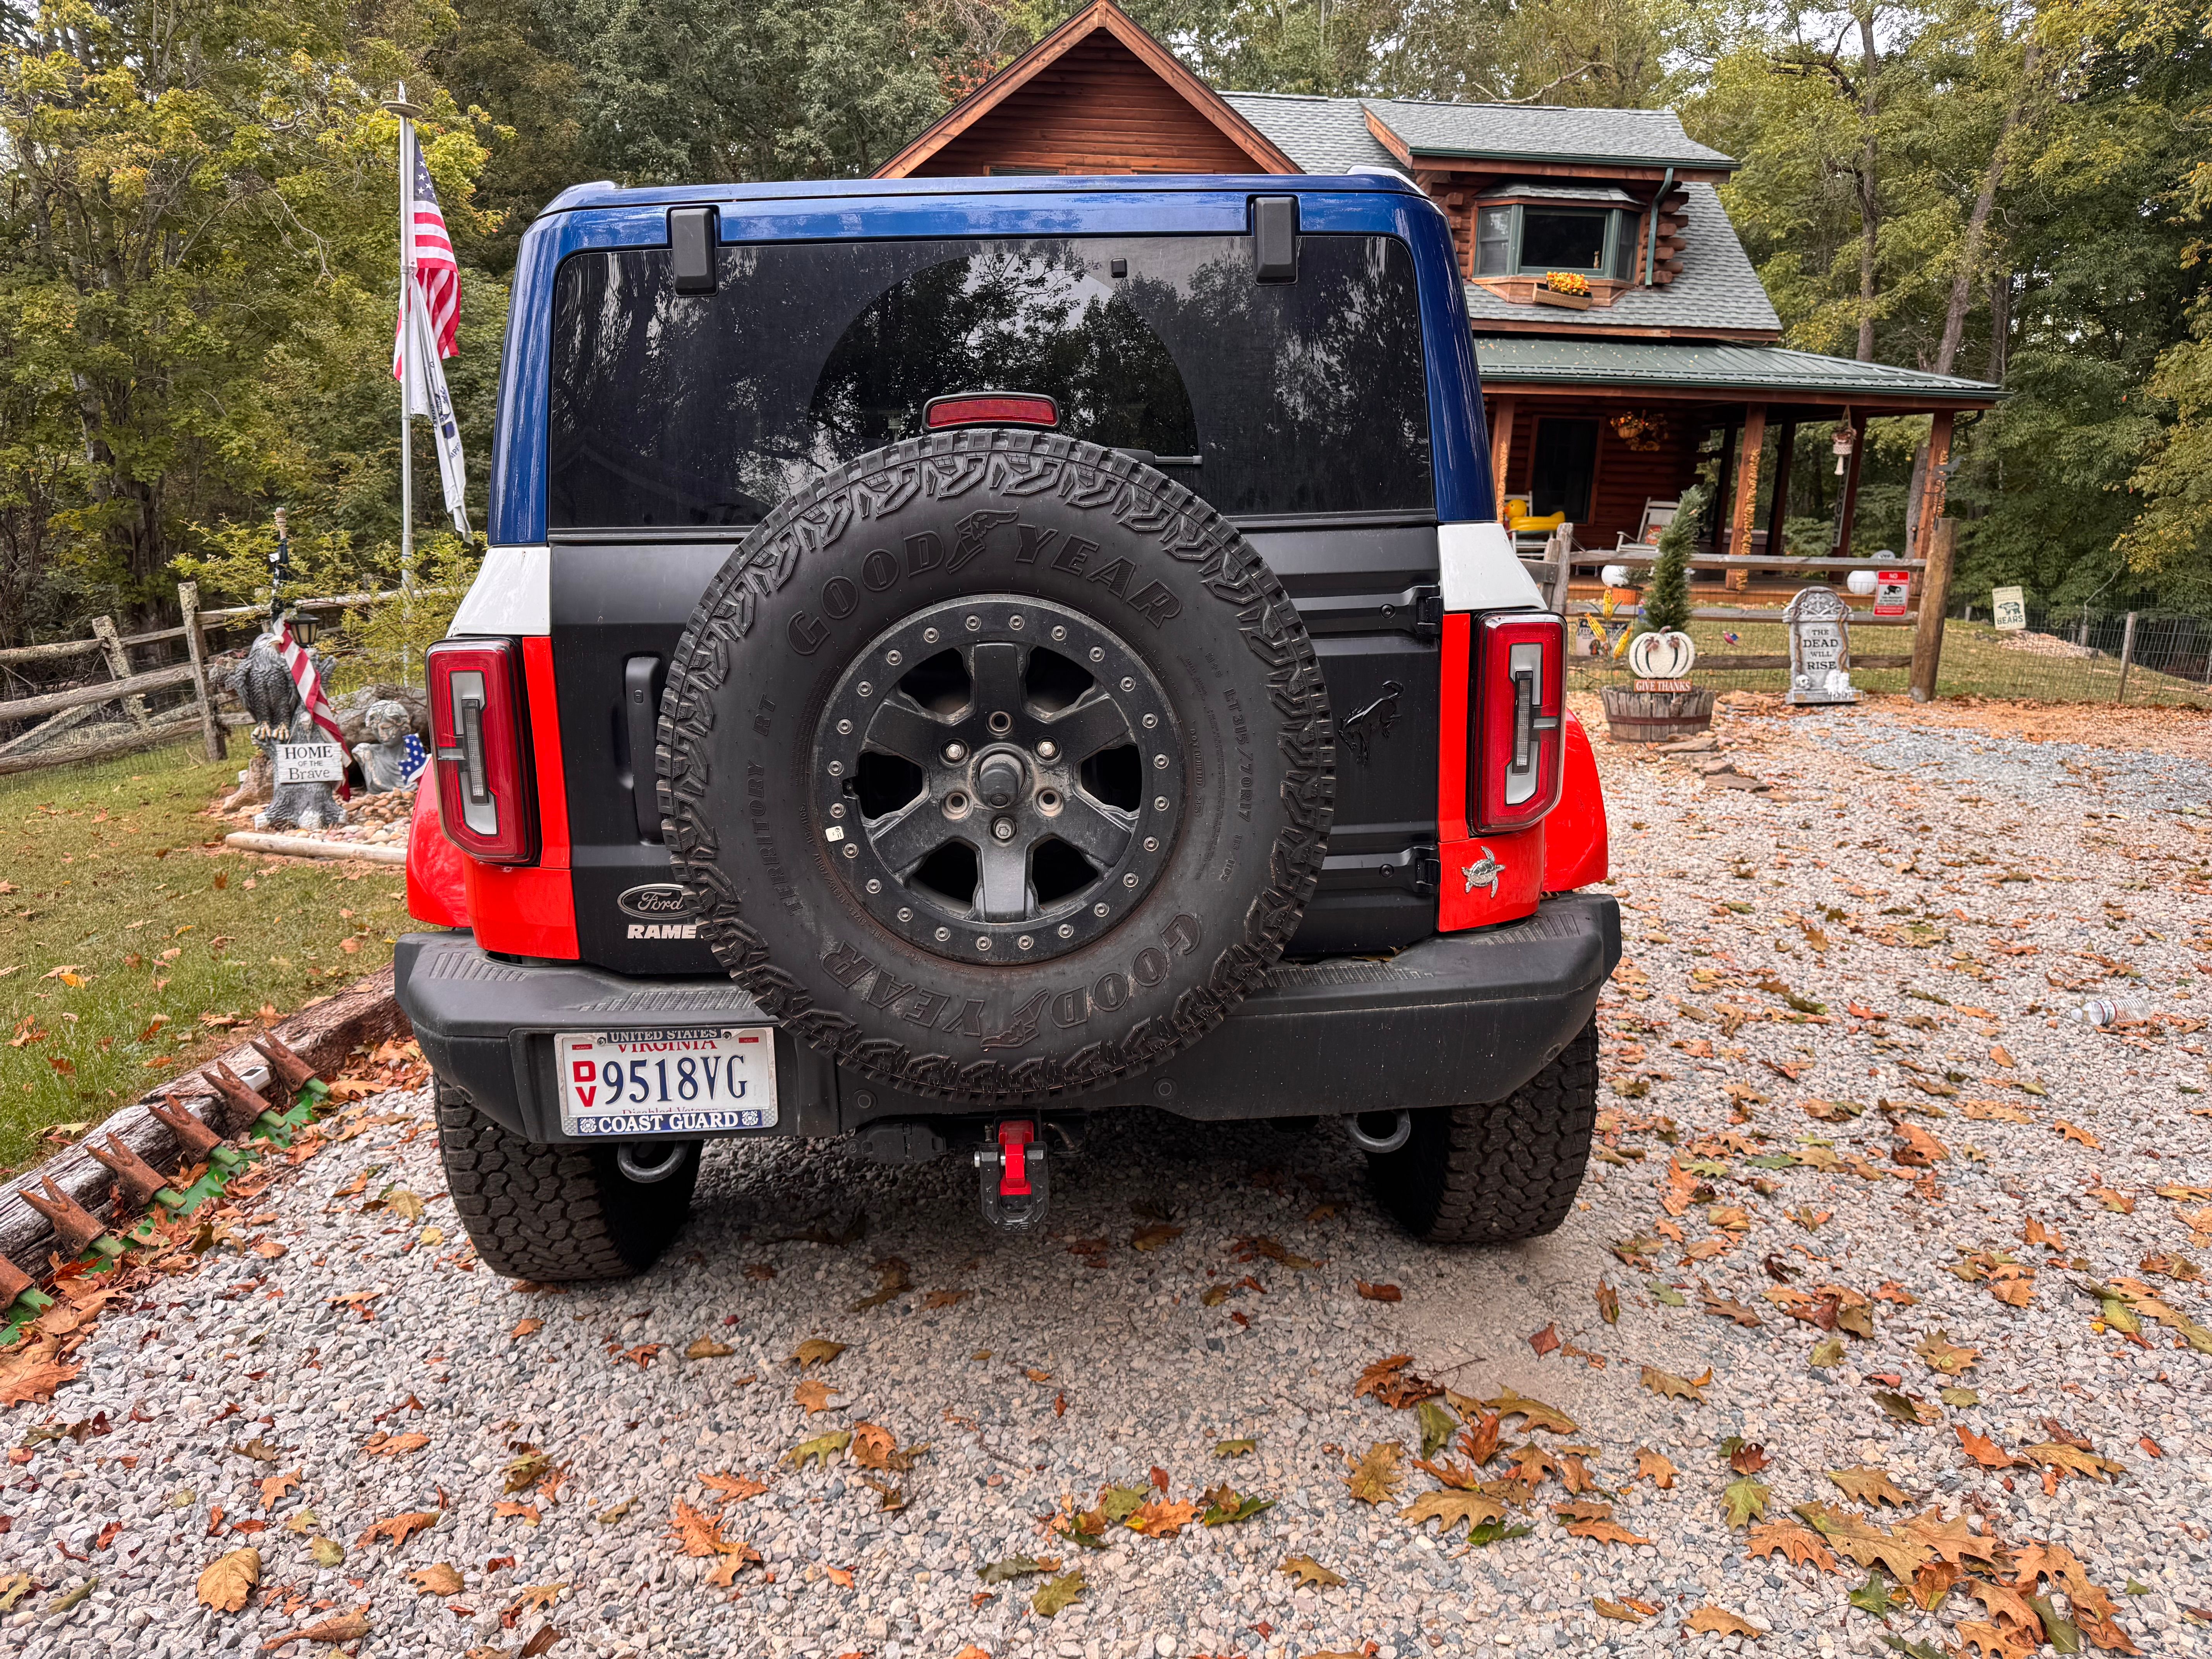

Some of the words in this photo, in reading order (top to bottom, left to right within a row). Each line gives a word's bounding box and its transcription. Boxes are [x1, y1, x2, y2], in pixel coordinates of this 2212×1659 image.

[787, 530, 945, 655] GOOD
[1014, 524, 1182, 628] YEAR
[1997, 615, 2023, 624] BEARS
[1803, 639, 1838, 647] DEAD
[1807, 661, 1836, 670] RISE
[1636, 681, 1655, 691] GIVE
[1657, 681, 1690, 691] THANKS
[752, 692, 775, 736] RT
[285, 746, 333, 759] HOME
[1223, 688, 1253, 822] LT315/70R17
[289, 768, 330, 781] Brave
[747, 760, 803, 915] TERRITORY
[637, 891, 684, 910] Ford
[627, 924, 704, 939] RAME
[871, 929, 886, 942] TIRE
[1051, 912, 1201, 1029] GOOD
[821, 940, 983, 1036] YEAR
[610, 1030, 663, 1042] UNITED
[666, 1029, 717, 1040] STATES
[602, 1054, 748, 1105] 9518VG
[598, 1114, 664, 1132] COAST
[669, 1111, 738, 1130] GUARD
